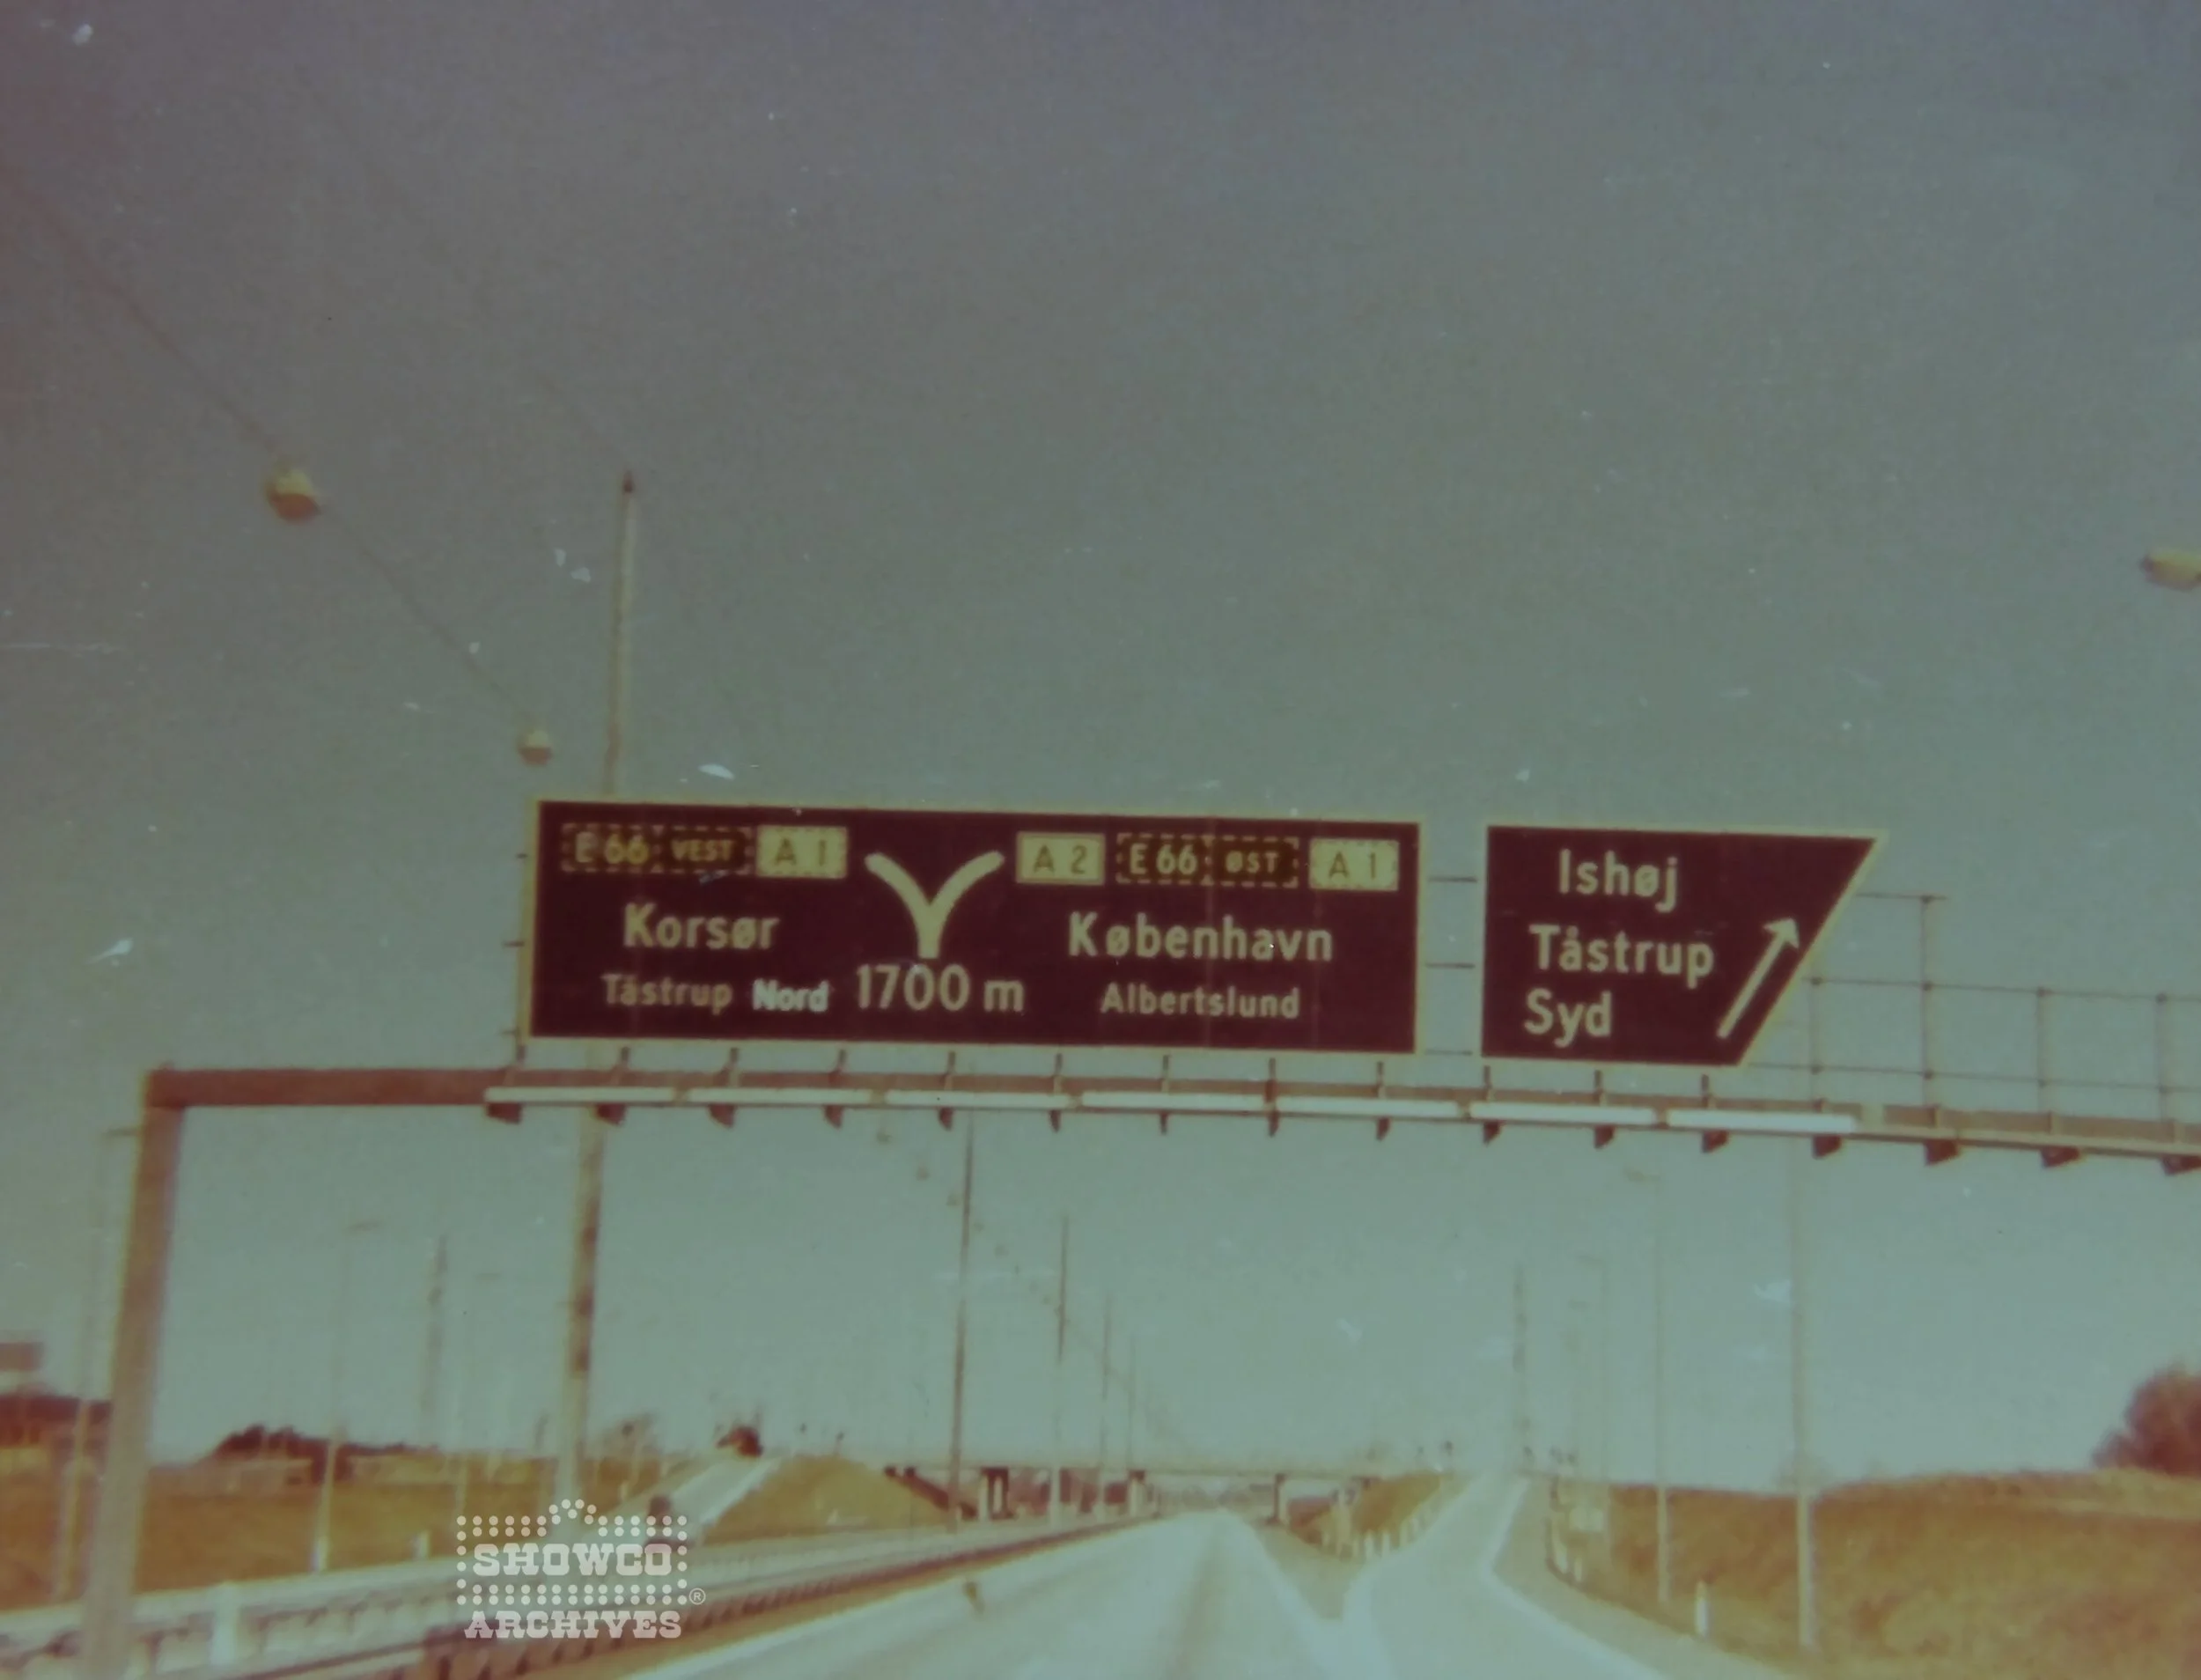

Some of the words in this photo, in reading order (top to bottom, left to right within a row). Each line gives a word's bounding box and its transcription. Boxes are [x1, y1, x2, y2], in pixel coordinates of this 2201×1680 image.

[604, 833, 650, 865] 66
[670, 838, 737, 862] VEST
[773, 838, 797, 866] A
[1032, 844, 1056, 873] A
[1071, 844, 1088, 874] 2
[1129, 843, 1147, 874] E
[1155, 844, 1198, 875] 66
[1327, 851, 1351, 879] A
[1558, 848, 1678, 913] Ishøj
[623, 903, 780, 950] Korsør
[1068, 911, 1333, 962] København
[1528, 924, 1715, 990] Tåstrup
[751, 978, 830, 1013] Nord
[856, 963, 969, 1012] 1700
[983, 979, 1025, 1012] m
[1100, 982, 1300, 1020] Albertslund
[1524, 989, 1613, 1049] Syd
